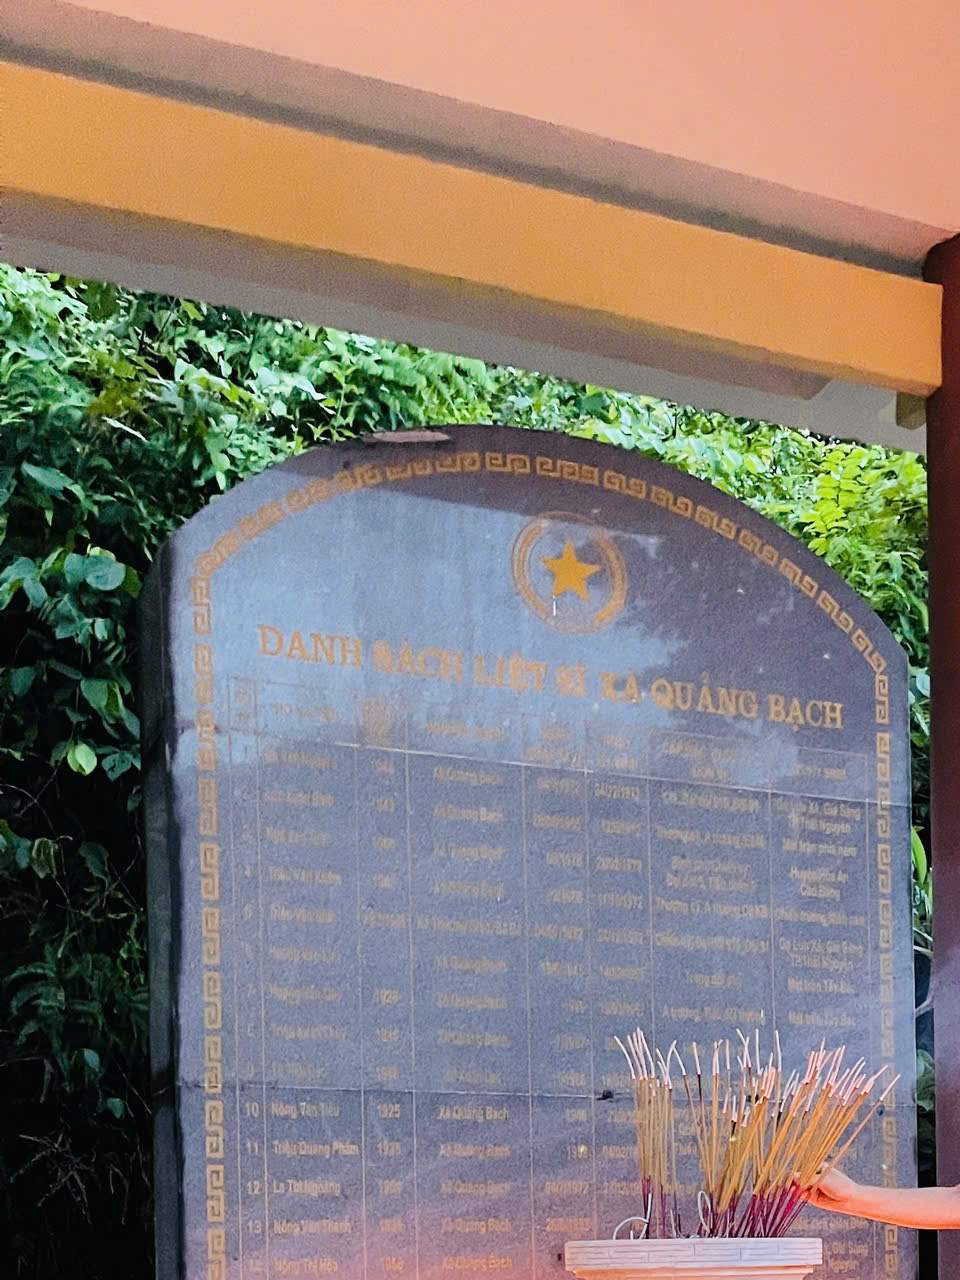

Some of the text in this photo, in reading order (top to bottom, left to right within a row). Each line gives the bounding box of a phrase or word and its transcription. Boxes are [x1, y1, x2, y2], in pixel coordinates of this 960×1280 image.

[258, 624, 364, 669] DANH
[372, 637, 464, 682] SÁCH
[475, 650, 548, 695] LIỆT
[650, 671, 760, 719] QUẢNG
[768, 694, 844, 732] BẠCH
